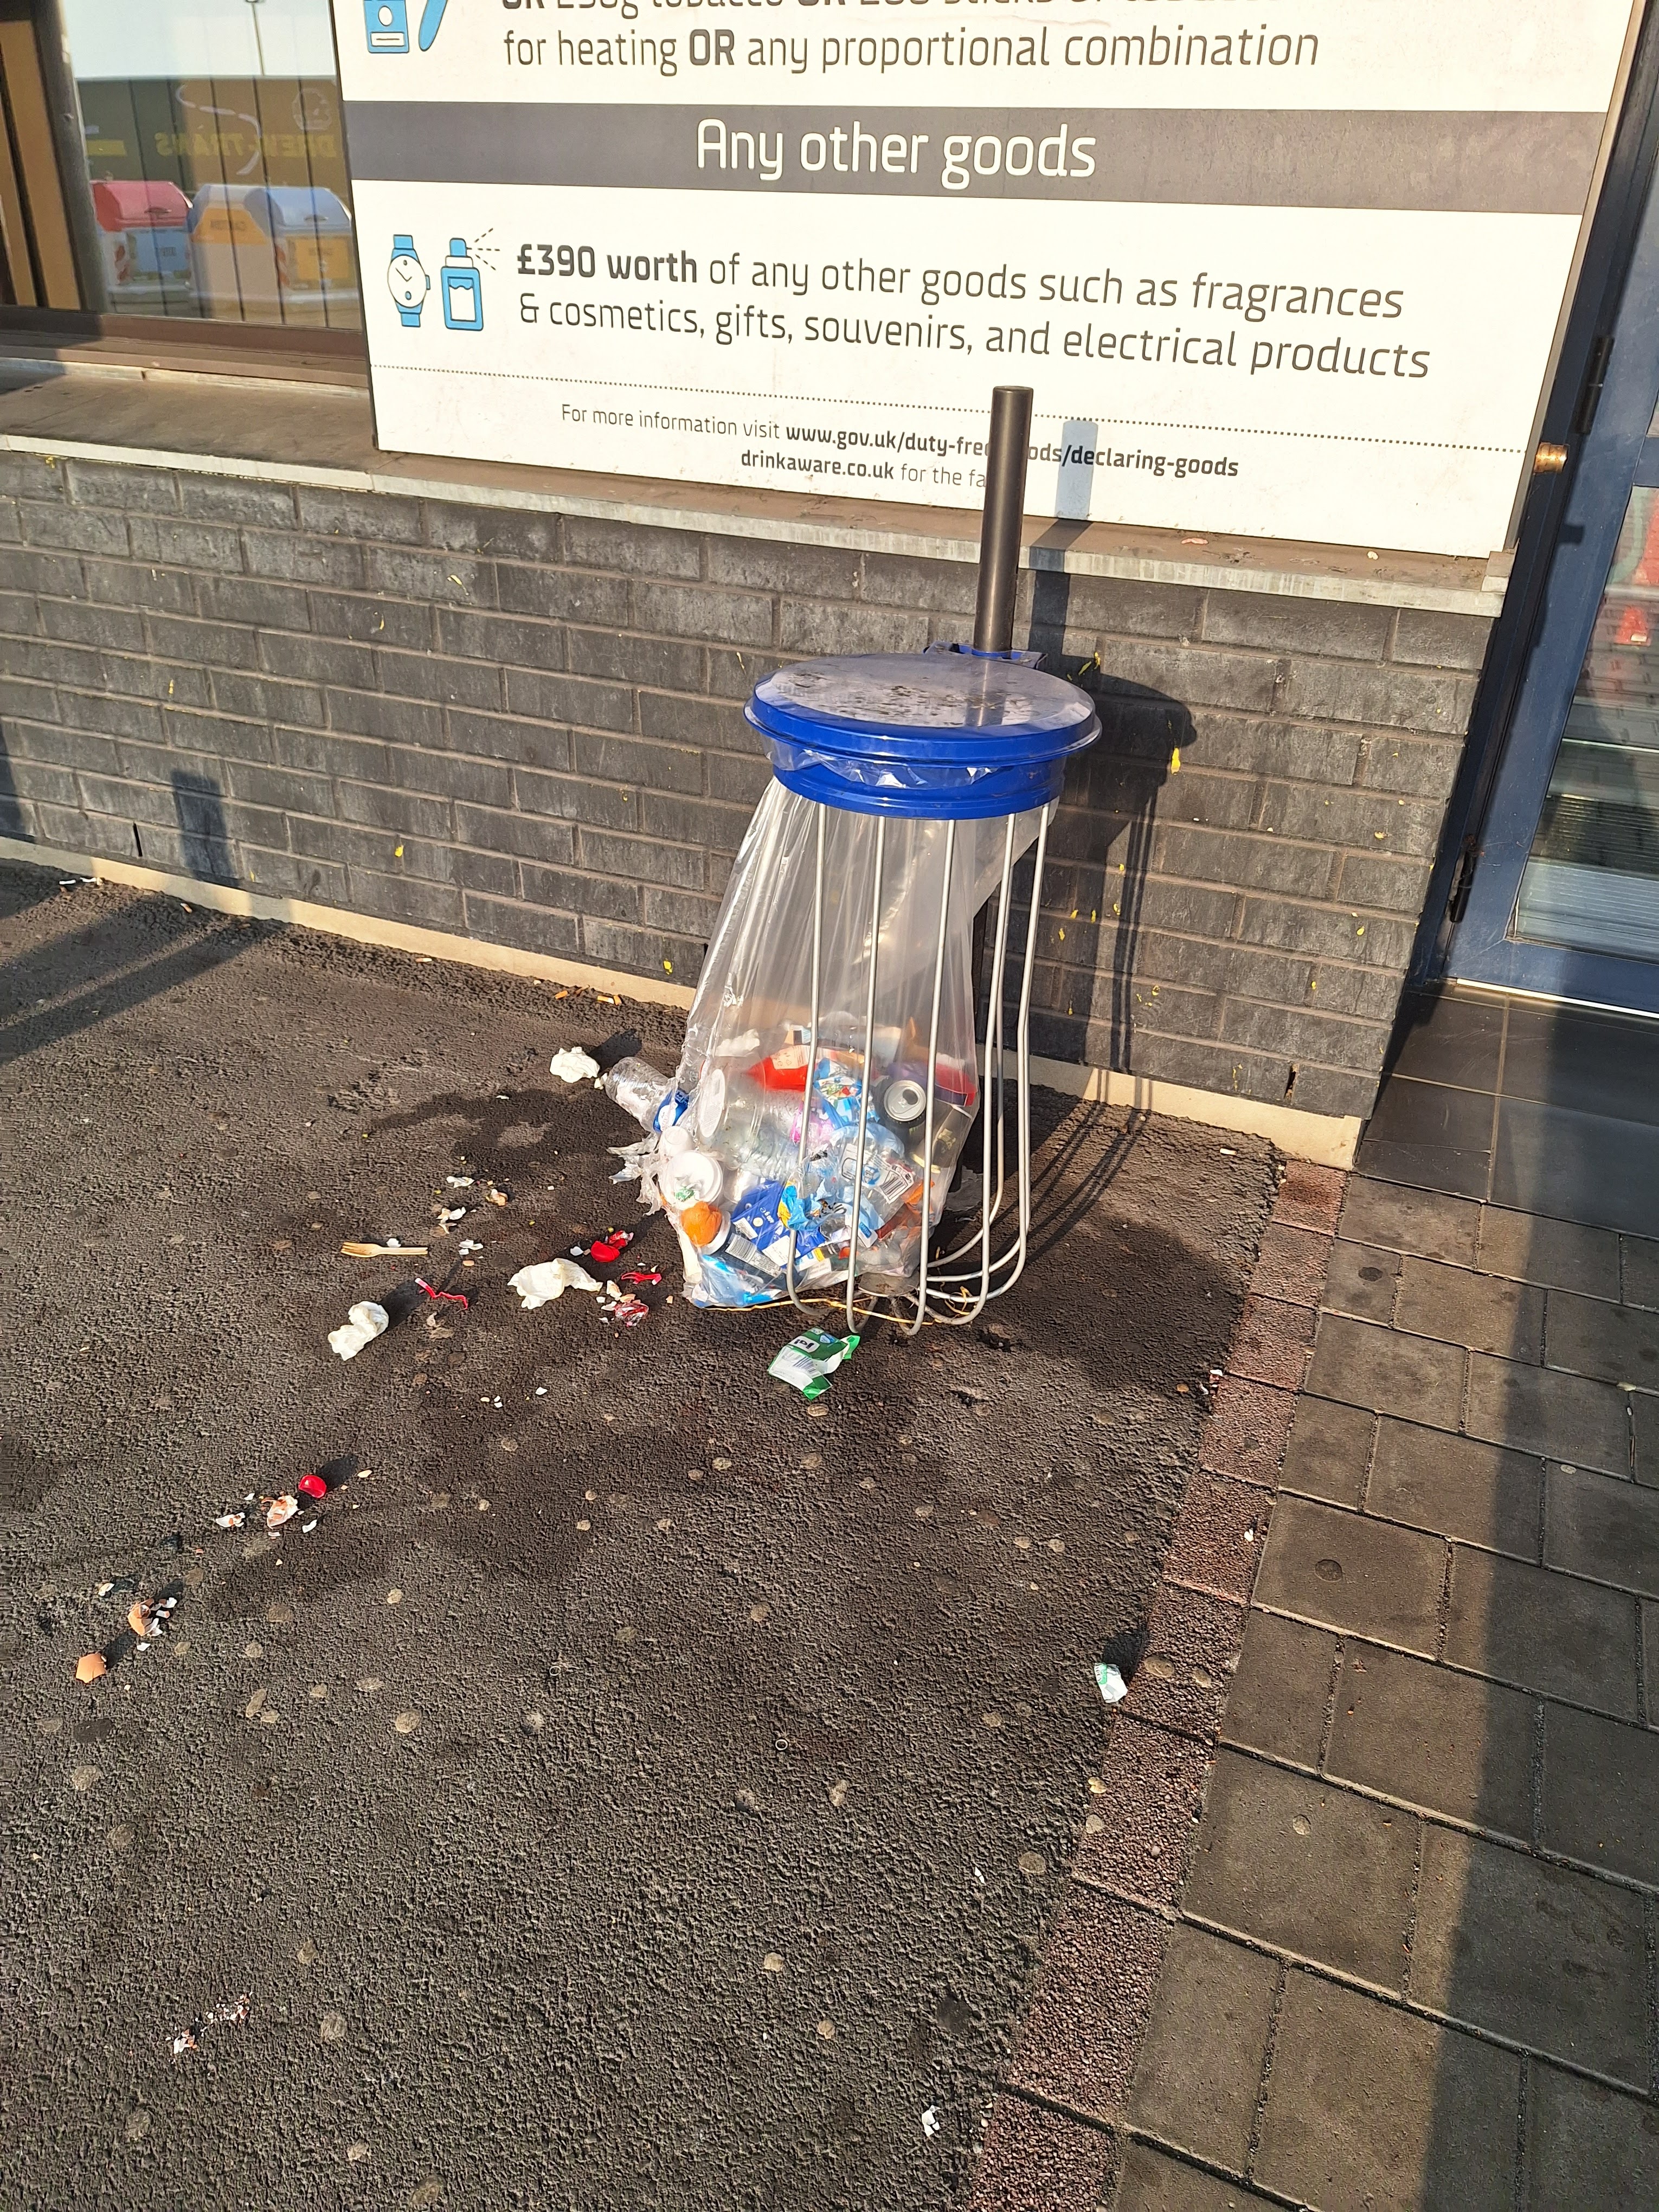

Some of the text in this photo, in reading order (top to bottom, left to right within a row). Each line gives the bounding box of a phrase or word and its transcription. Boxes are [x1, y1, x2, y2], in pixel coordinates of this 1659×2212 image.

[504, 24, 1318, 76] for heating OR any proportional combination
[697, 118, 1096, 190] Any other goods
[517, 244, 1404, 322] £390 worth of any other goods such as fragrances
[520, 293, 1430, 378] & cosmetics, gifts, souvenirs, and electrical products
[562, 404, 1238, 478] For more information visit www.gov.uk/duty-freods/declaring-goods
[742, 450, 893, 479] drinkaware.co.uk
[901, 464, 926, 482] for
[933, 467, 962, 486] the
[794, 1339, 814, 1349] ja!
